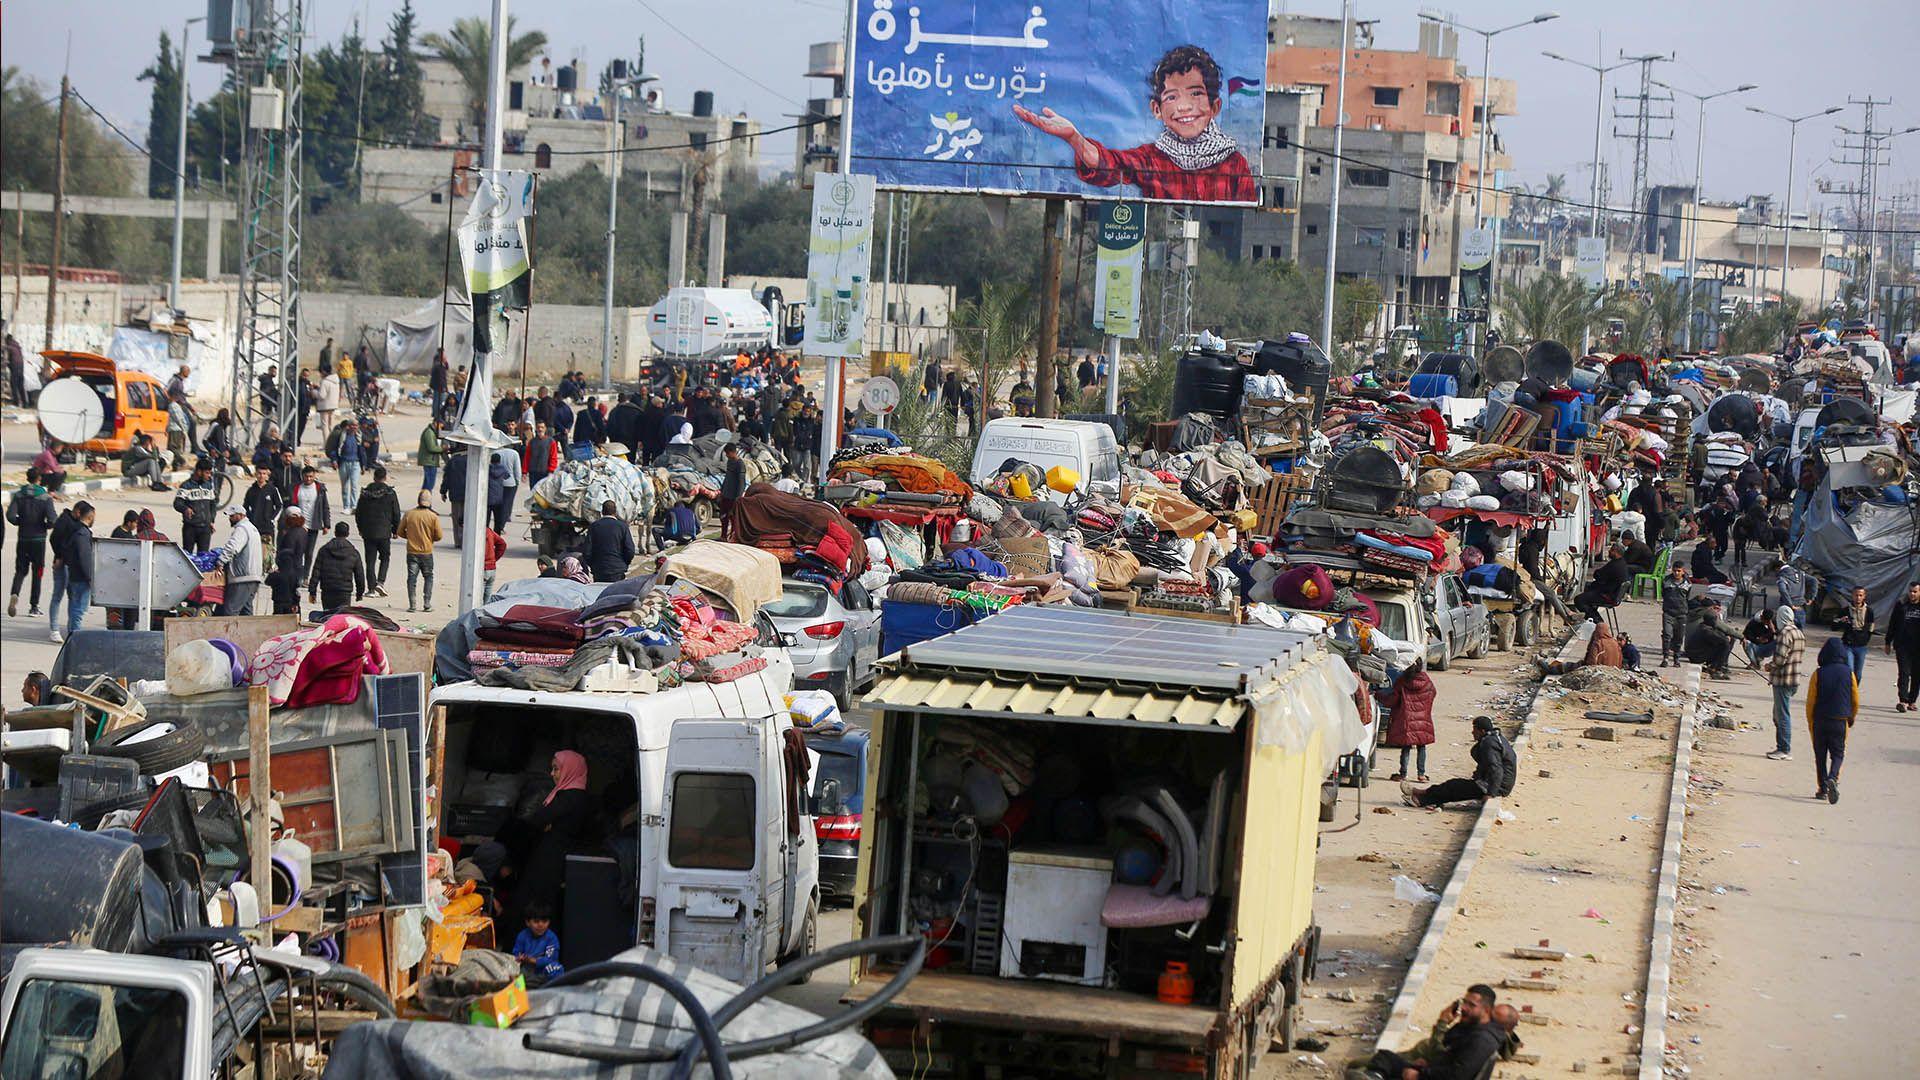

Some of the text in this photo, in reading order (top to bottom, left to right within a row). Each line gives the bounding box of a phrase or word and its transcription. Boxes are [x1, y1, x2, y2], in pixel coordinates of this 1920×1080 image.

[868, 53, 952, 95] بأهلها
[820, 216, 862, 228] لا مثيل لها
[1105, 231, 1138, 240] لا مثيل لها
[475, 237, 488, 253] لها
[872, 388, 889, 403] 80
